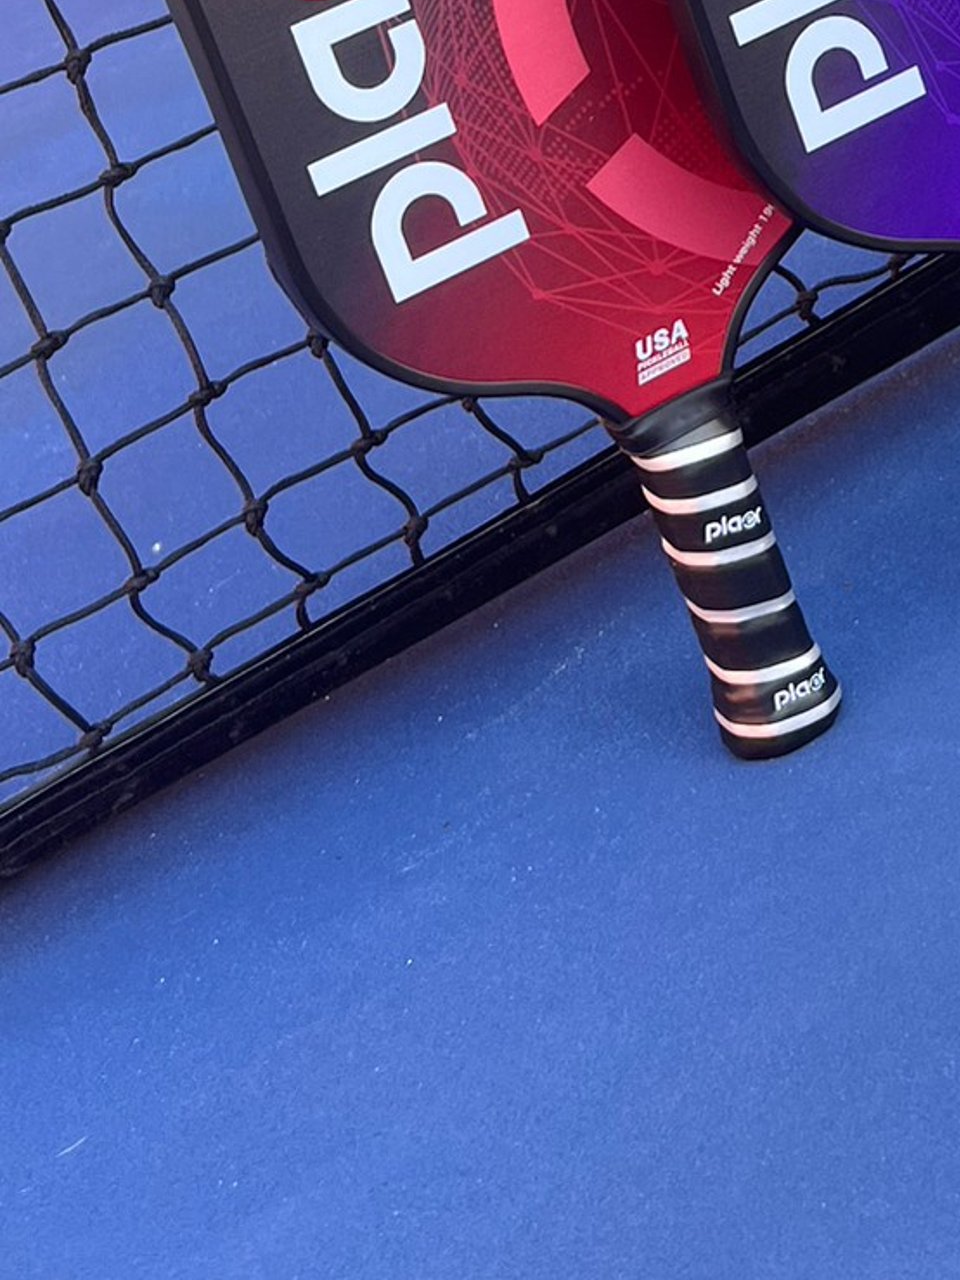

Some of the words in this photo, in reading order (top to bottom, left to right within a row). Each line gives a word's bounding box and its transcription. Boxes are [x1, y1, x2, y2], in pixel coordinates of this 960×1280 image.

[712, 264, 737, 296] Light
[733, 224, 762, 264] weight
[635, 318, 689, 361] USA
